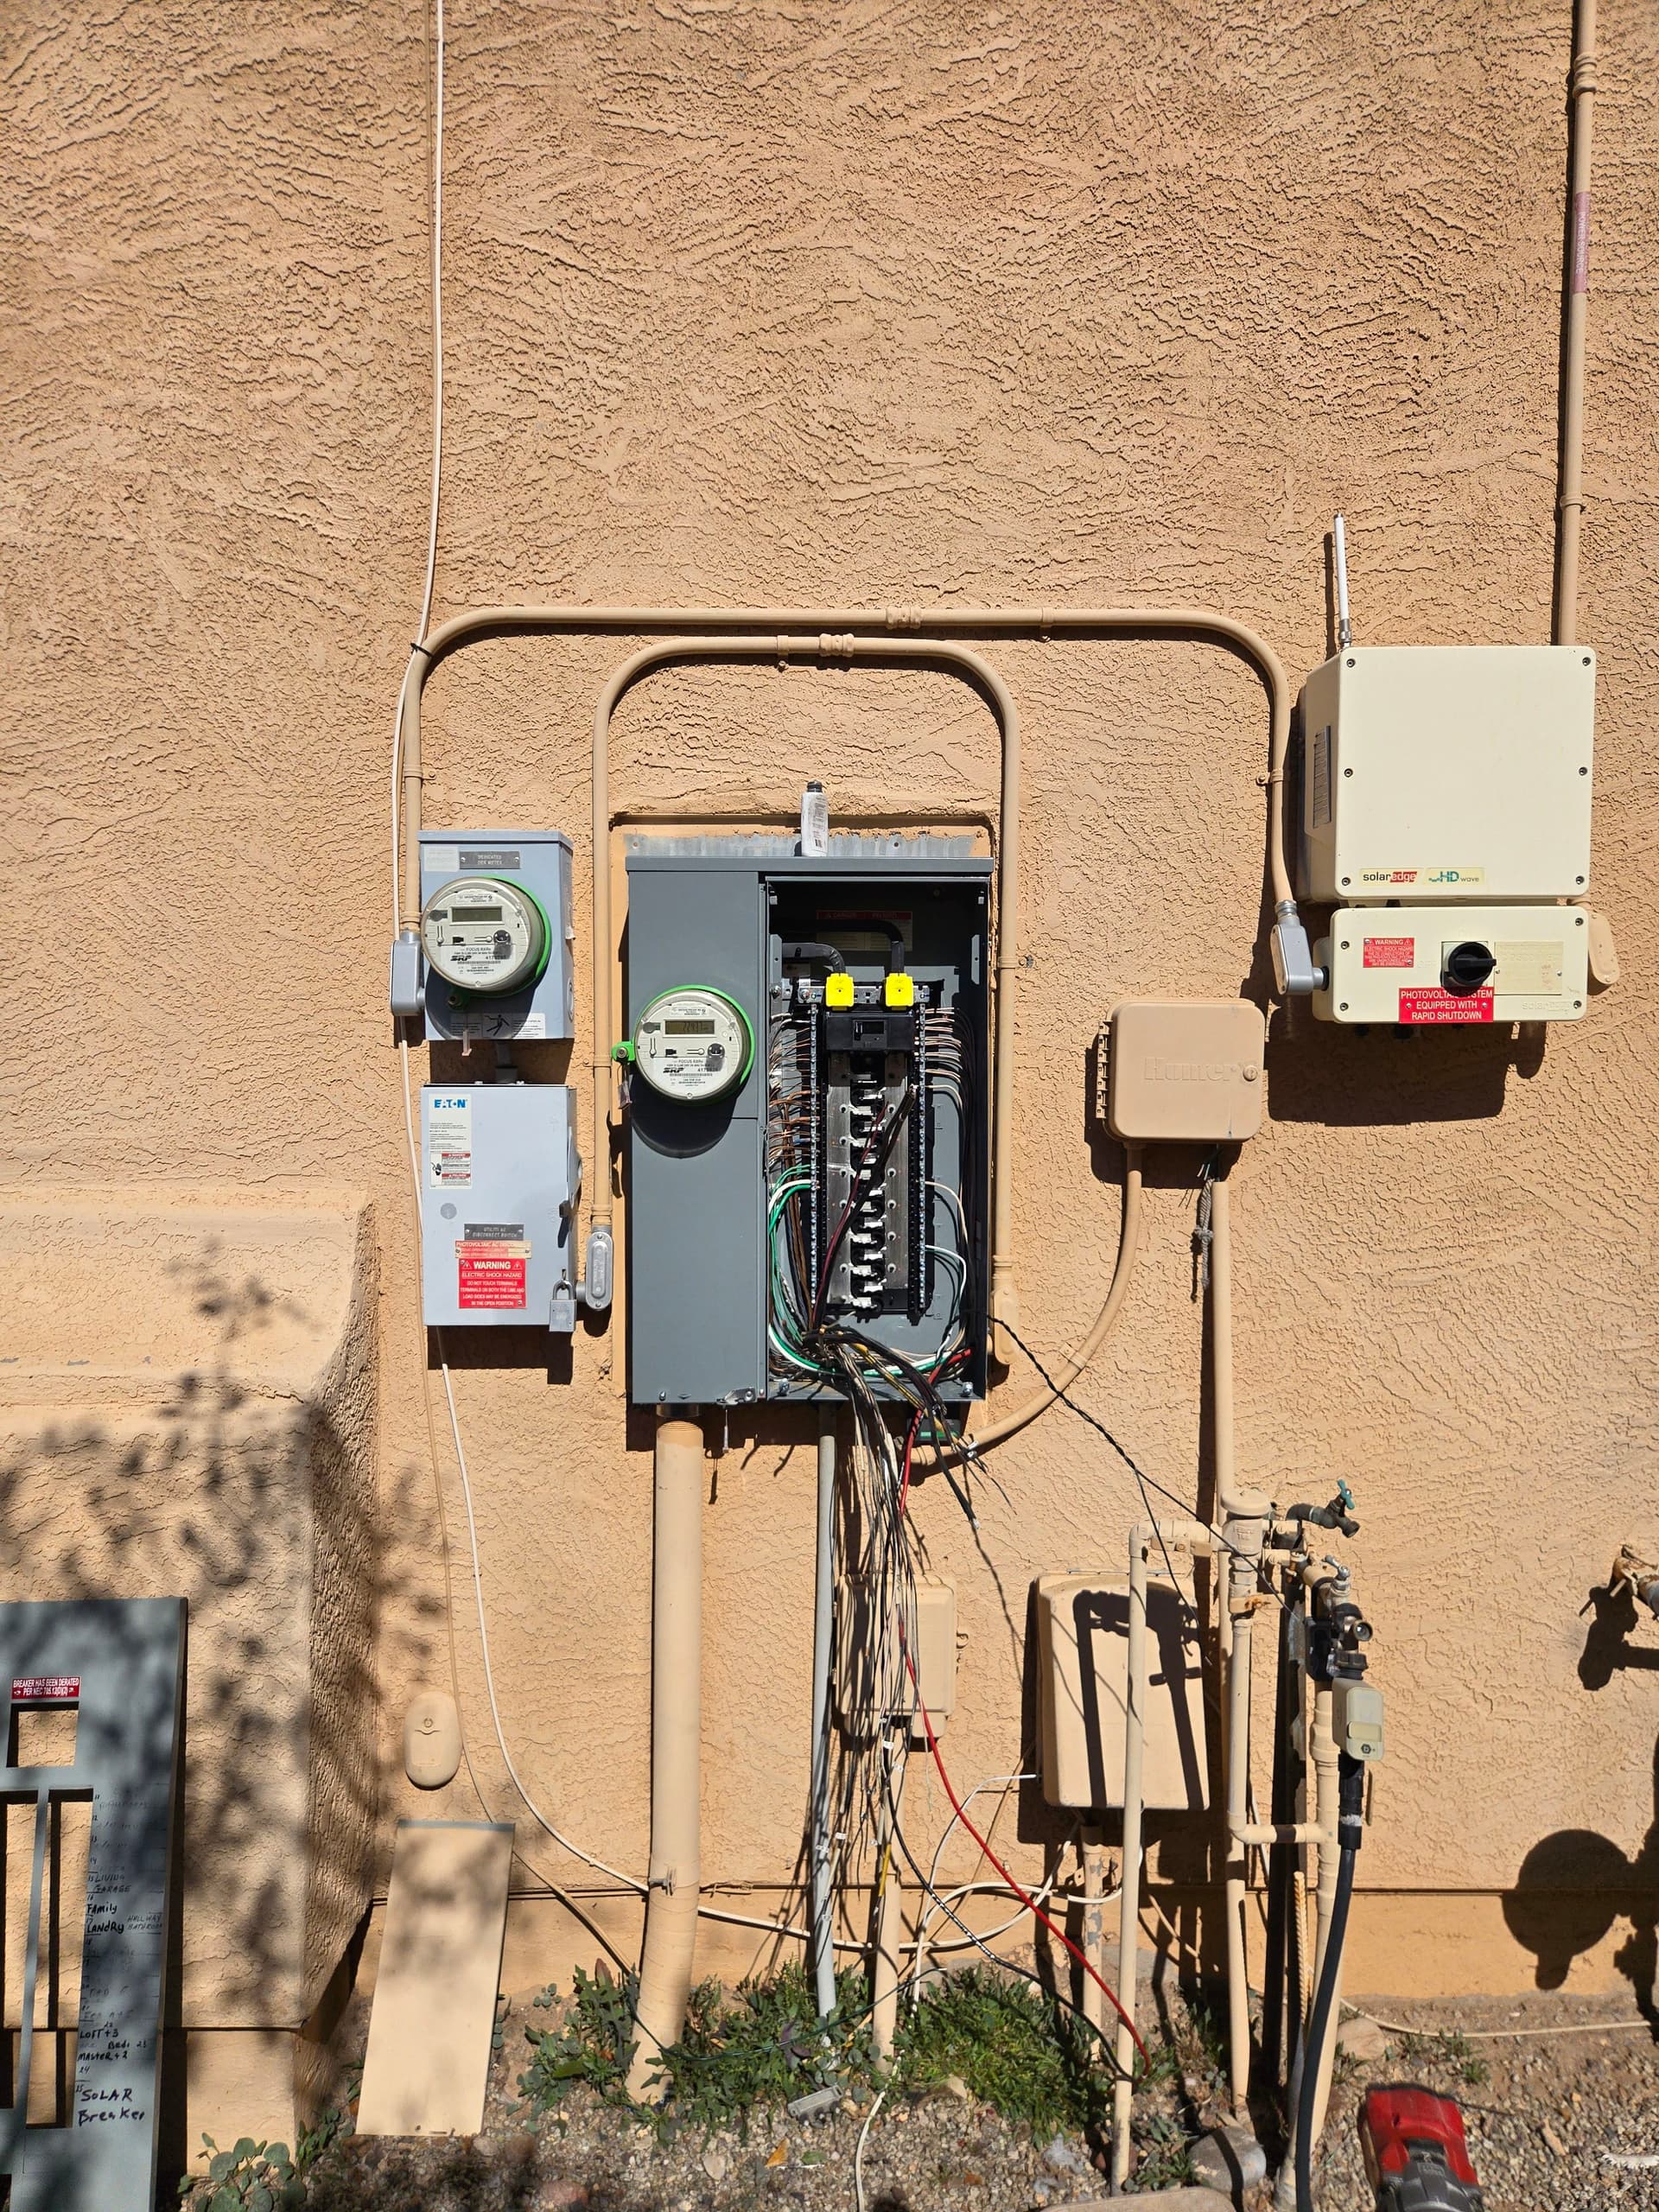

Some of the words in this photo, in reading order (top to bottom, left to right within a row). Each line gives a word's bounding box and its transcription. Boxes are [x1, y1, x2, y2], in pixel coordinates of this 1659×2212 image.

[1363, 871, 1417, 882] solaredge
[1401, 989, 1459, 999] PHOTOVOLTA
[1416, 1001, 1456, 1009] EQUIPPED
[1411, 1012, 1435, 1020] RAPID
[1437, 1011, 1482, 1020] SHUTDOWN
[474, 1261, 512, 1269] WARNING
[13, 1679, 35, 1688] BREAKER
[35, 1678, 45, 1687] HAS
[46, 1678, 58, 1687] BEEN
[58, 1677, 79, 1687] DERATED
[23, 1688, 33, 1696] PER
[95, 1874, 125, 1883] LIVING
[93, 1884, 131, 1893] GARAGE
